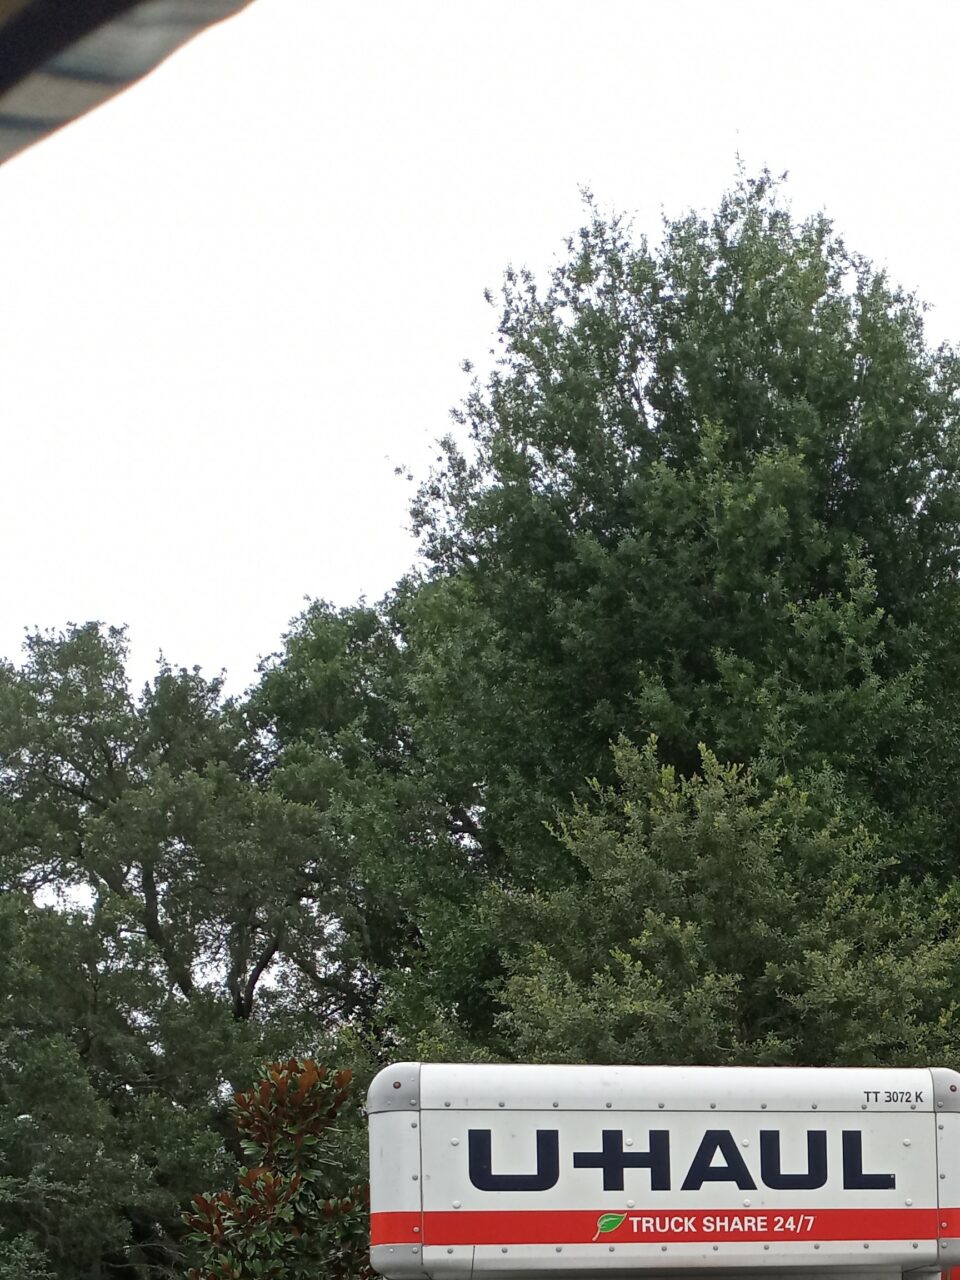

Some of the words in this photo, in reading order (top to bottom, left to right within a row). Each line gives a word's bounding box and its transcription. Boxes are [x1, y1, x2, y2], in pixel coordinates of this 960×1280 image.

[863, 1091, 880, 1103] TT
[885, 1091, 911, 1103] 3072
[915, 1091, 924, 1103] K
[468, 1128, 896, 1192] U-HAUL
[629, 1215, 697, 1233] TRUCK
[702, 1215, 768, 1232] SHARE
[773, 1213, 816, 1233] 24/7
